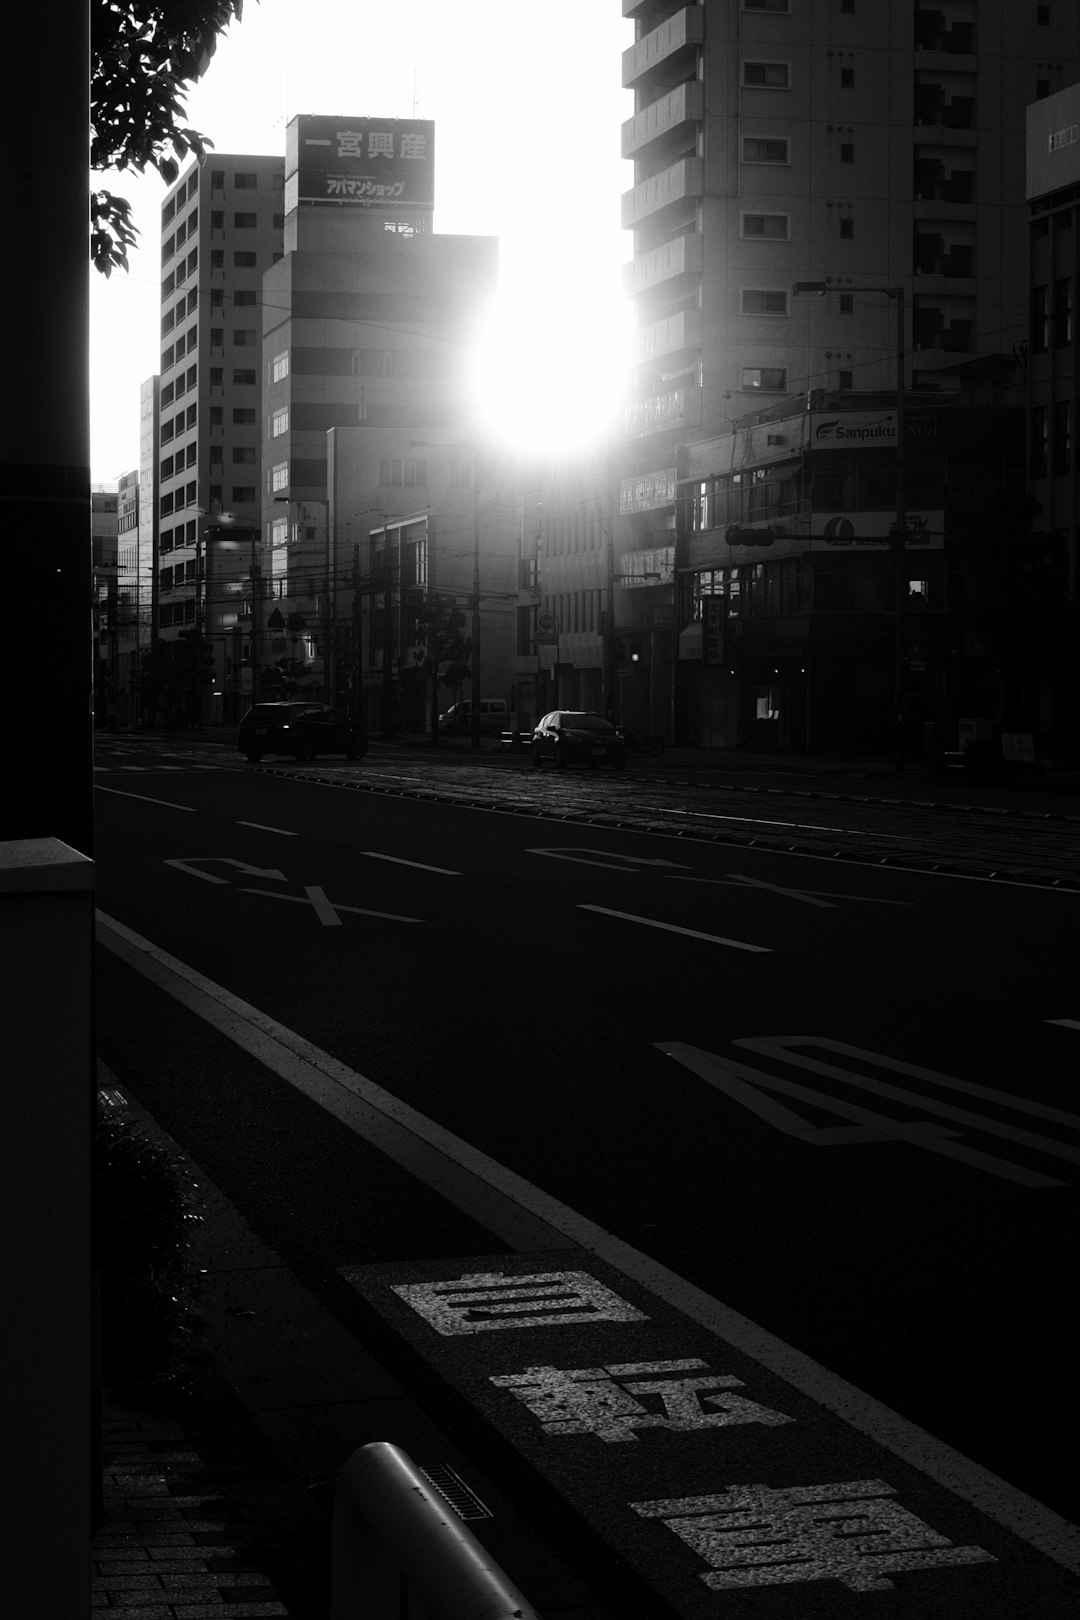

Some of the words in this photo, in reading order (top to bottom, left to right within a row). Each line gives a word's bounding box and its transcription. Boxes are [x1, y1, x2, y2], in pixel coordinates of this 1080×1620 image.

[305, 130, 427, 160] 一宮興産
[326, 178, 405, 197] アパマンショップ
[835, 425, 895, 441] Sanpuku
[390, 1271, 998, 1591] 自転車
